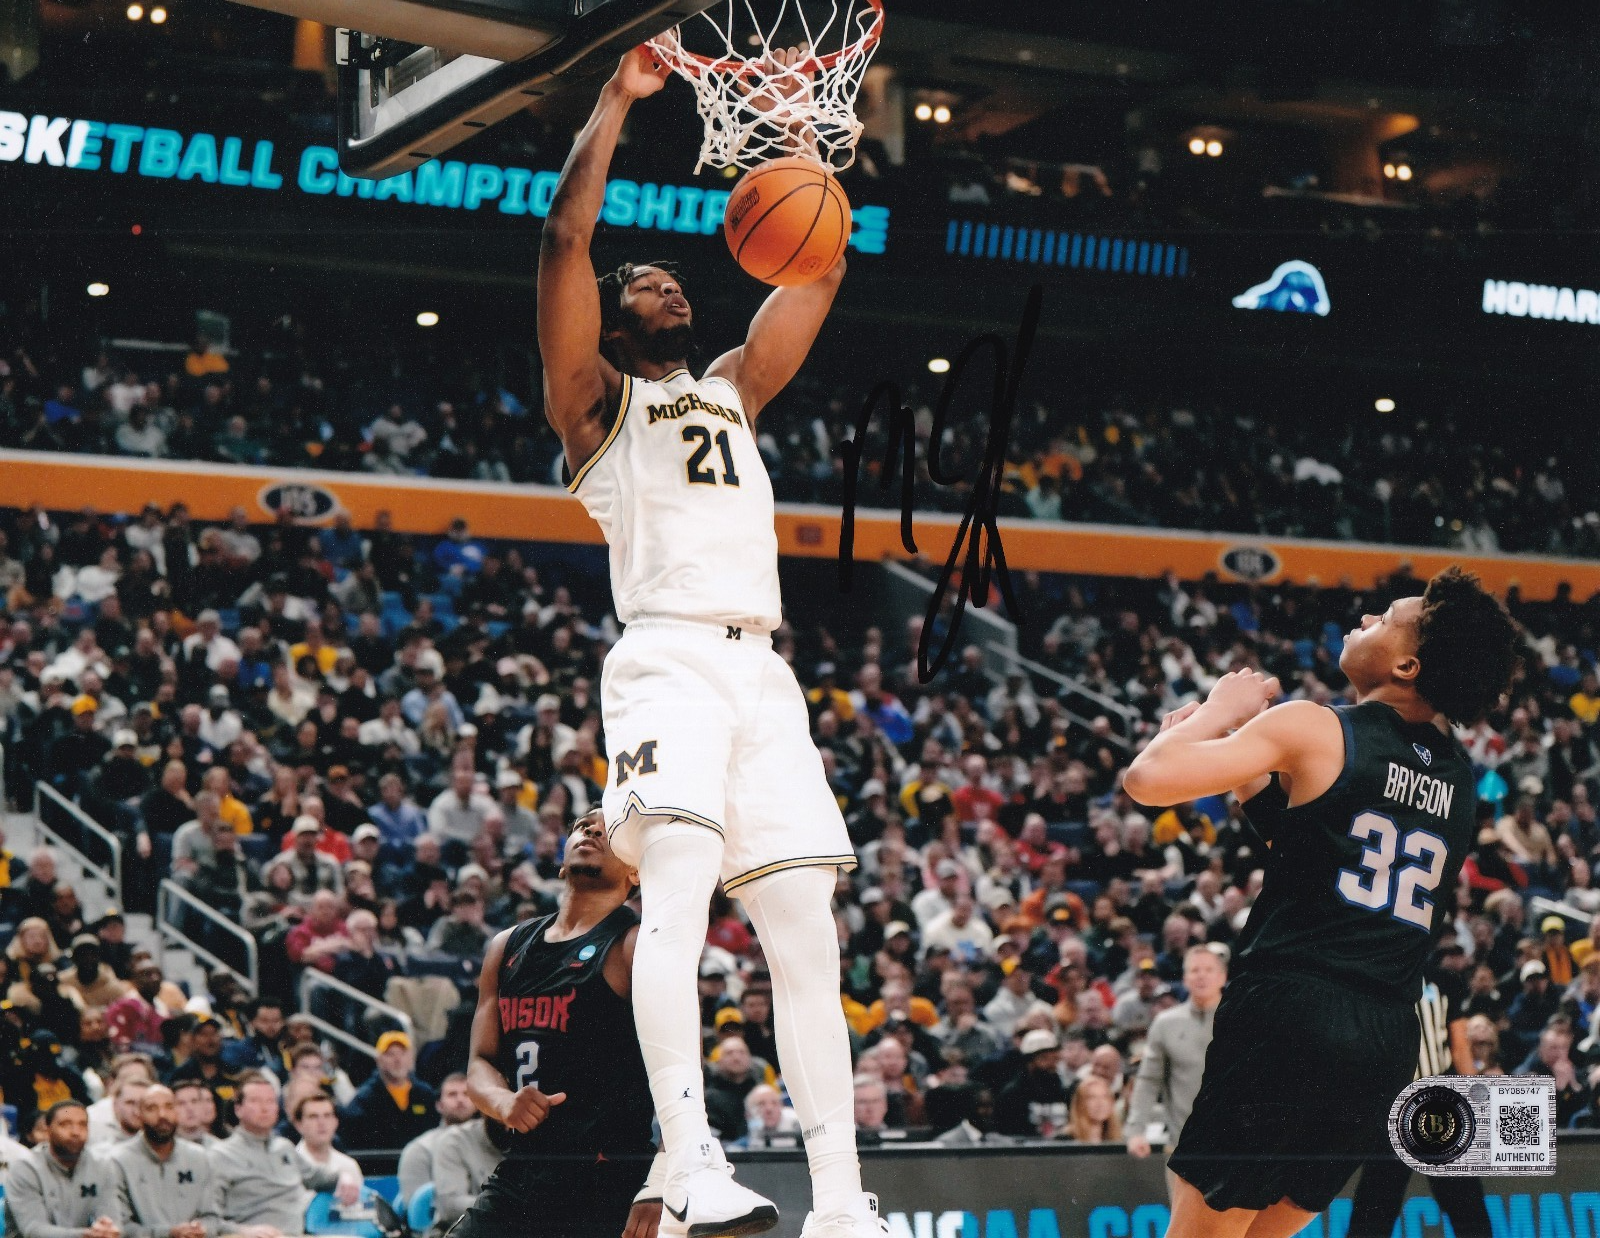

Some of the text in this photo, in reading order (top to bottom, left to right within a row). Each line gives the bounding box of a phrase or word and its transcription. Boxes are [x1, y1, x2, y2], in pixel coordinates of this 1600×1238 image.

[1482, 278, 1600, 325] HOWAR
[646, 393, 743, 428] MICHGAN
[681, 425, 740, 488] 21
[726, 625, 742, 641] M
[615, 740, 658, 788] M
[1383, 762, 1455, 820] BRYSON
[1335, 808, 1450, 935] 32
[498, 987, 577, 1034] BISON
[514, 1040, 540, 1092] 2
